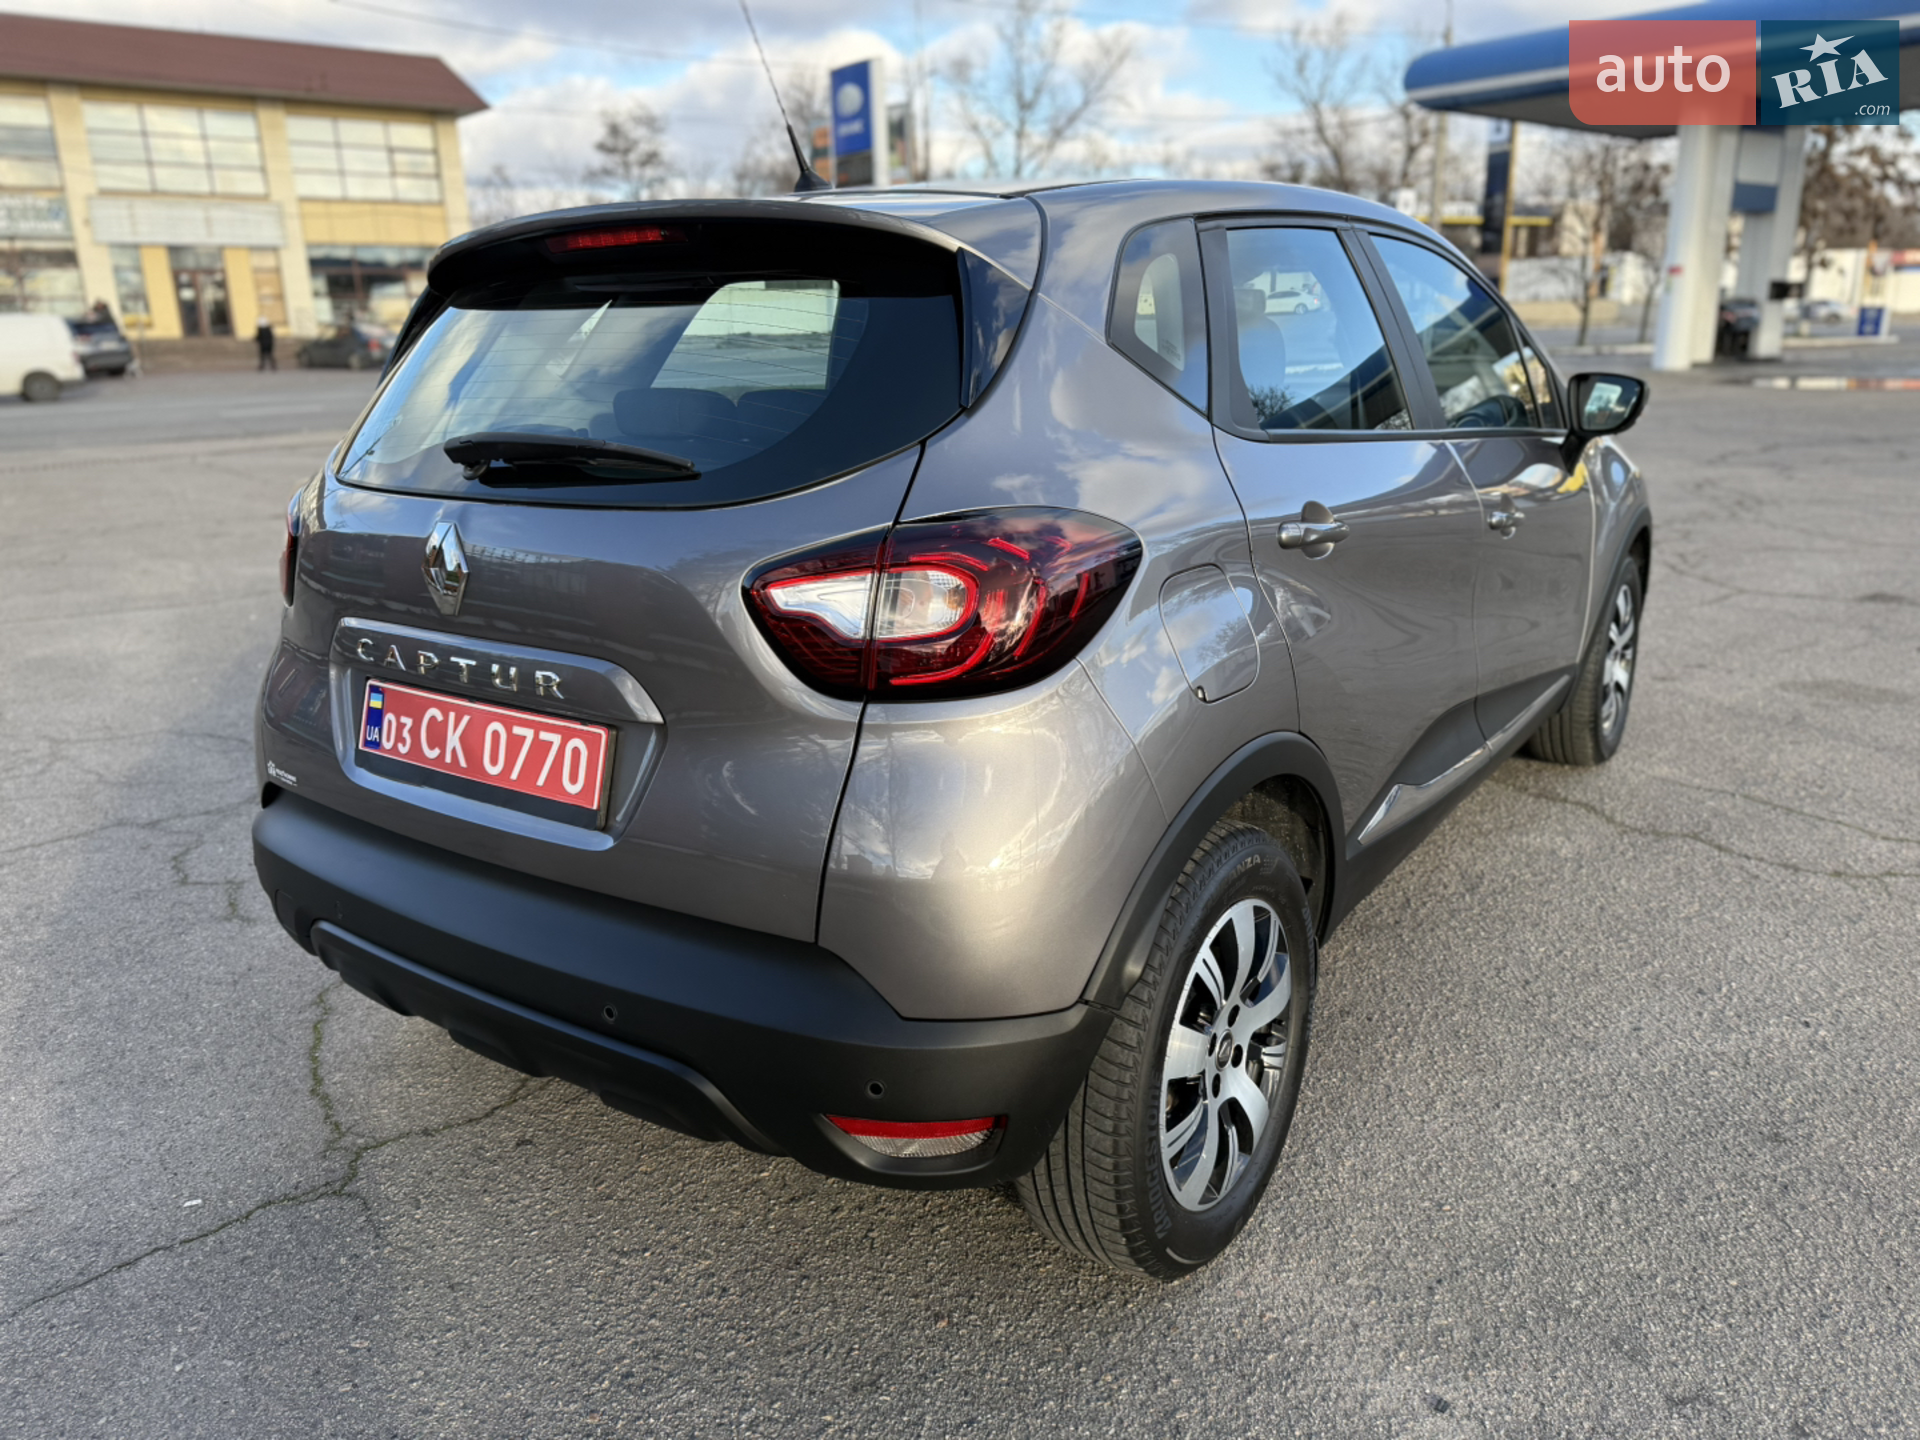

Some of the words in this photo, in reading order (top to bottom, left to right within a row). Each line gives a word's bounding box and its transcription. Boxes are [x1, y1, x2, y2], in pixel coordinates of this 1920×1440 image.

[357, 638, 565, 699] CAPTUR
[366, 724, 380, 743] UA
[381, 712, 414, 755] 03
[420, 707, 471, 769] CK
[482, 721, 589, 796] 0770
